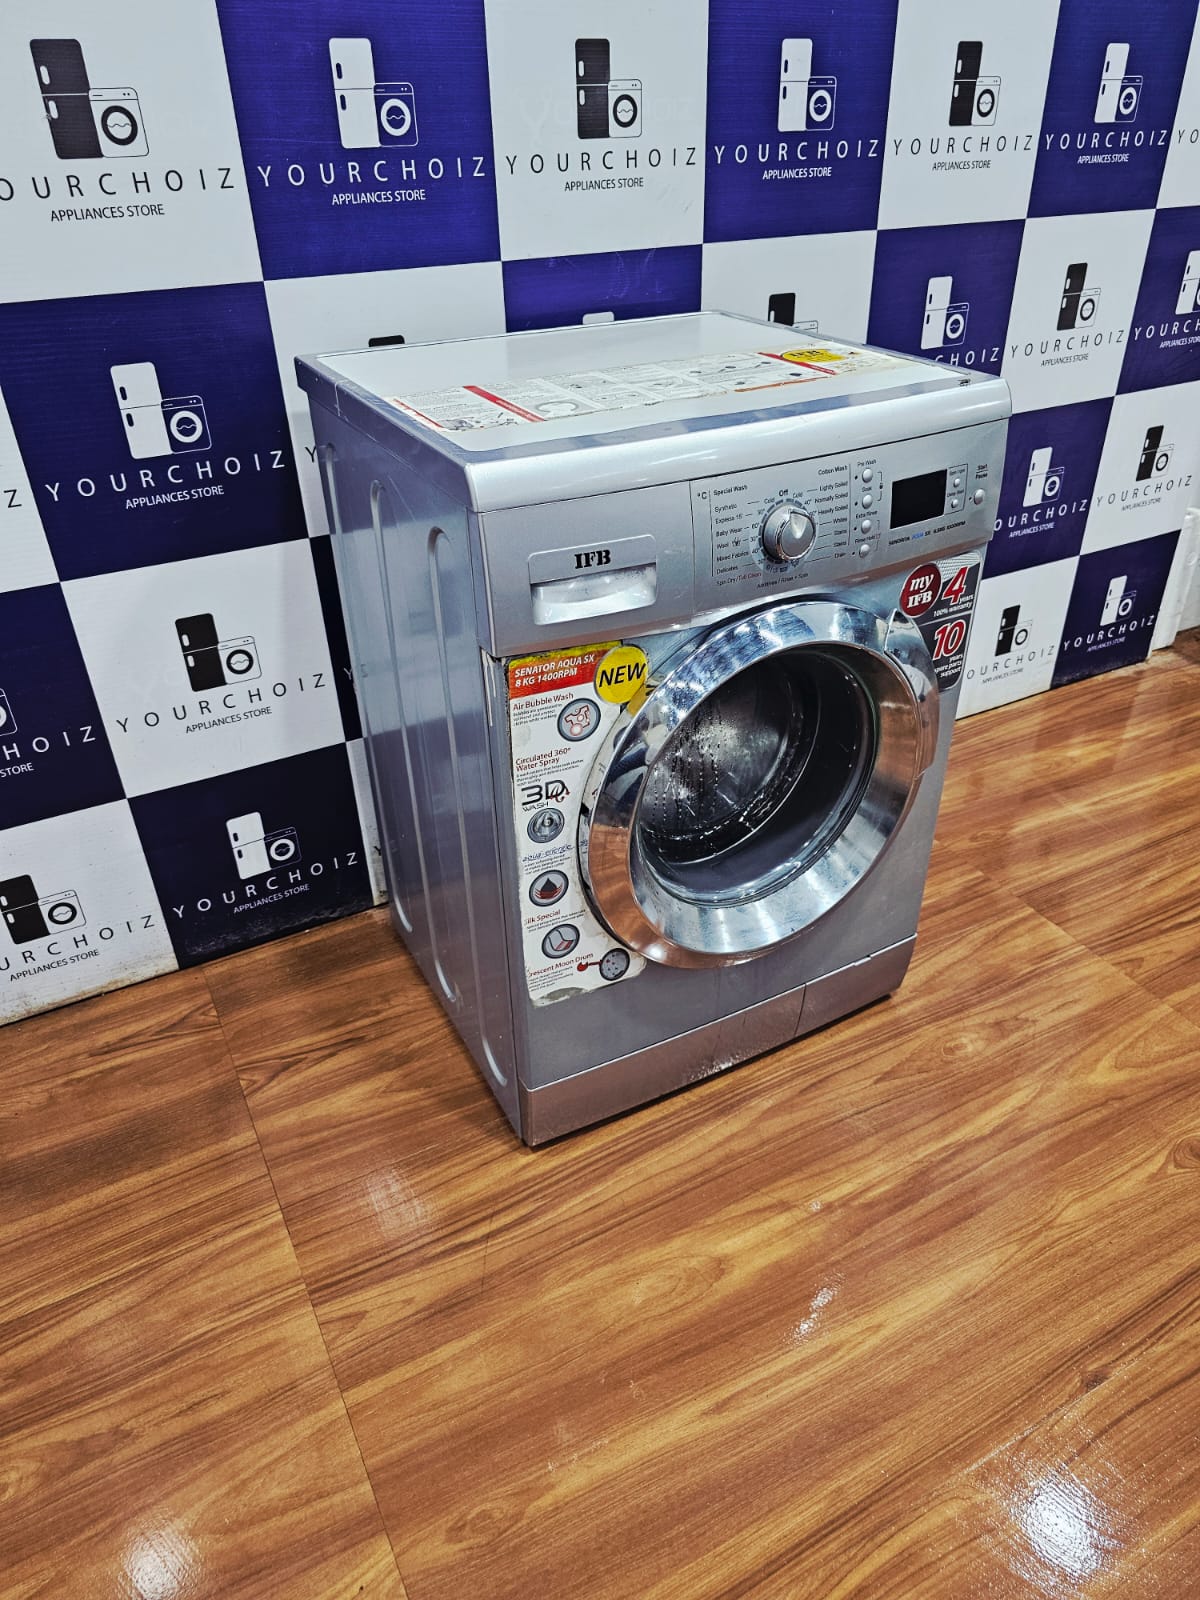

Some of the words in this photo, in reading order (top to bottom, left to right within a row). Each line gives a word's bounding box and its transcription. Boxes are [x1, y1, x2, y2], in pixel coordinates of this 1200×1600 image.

[893, 135, 1033, 156] YOURCHOIZ
[1044, 130, 1168, 151] YOURCHOIZ
[505, 147, 697, 175] YOURCHOIZ
[715, 139, 879, 165] YOURCHOIZ
[1078, 154, 1111, 164] APPLIANCES
[1111, 153, 1130, 163] STORE
[258, 157, 486, 187] YOURCHOIZ
[763, 168, 801, 180] APPLIANCES
[802, 167, 832, 178] STORE
[932, 161, 965, 171] APPLIANCES
[966, 160, 991, 169] STORE
[564, 181, 615, 193] APPLIANCES
[617, 177, 643, 189] STORE
[332, 192, 394, 206] APPLIANCES
[396, 189, 426, 202] STORE
[50, 206, 125, 222] APPLIANCES
[127, 204, 165, 218] STORE
[1011, 329, 1125, 359] YOURCHOIZ
[1040, 355, 1072, 367] APPLIANCES
[1072, 353, 1089, 363] STORE
[46, 450, 285, 502] YOURCHOIZ
[3, 489, 22, 508] Z
[125, 489, 190, 510] APPLIANCES
[191, 485, 224, 500] STORE
[778, 489, 789, 497] Off
[1096, 475, 1193, 507] YOURCHOIZ
[1008, 526, 1038, 538] APPLIANCES
[1038, 522, 1055, 533] STORE
[574, 549, 611, 569] IFB
[910, 574, 934, 593] my
[941, 566, 969, 606] 4
[907, 590, 933, 609] IFB
[932, 619, 966, 660] 10
[1063, 615, 1155, 652] YOURCHOIZ
[514, 662, 555, 678] SENATOR
[555, 657, 582, 670] AQUA
[583, 653, 595, 665] SX
[598, 662, 647, 688] NEW
[515, 680, 521, 688] 8
[522, 676, 535, 687] KG
[537, 667, 578, 683] 1400RPM
[116, 673, 326, 733] YOURCHOIZ
[513, 703, 524, 711] Air
[525, 696, 553, 709] Bubble
[553, 692, 574, 703] Wash
[185, 714, 242, 734] APPLIANCES
[243, 706, 272, 721] STORE
[515, 750, 553, 766] Circulated
[516, 761, 538, 772] Water
[539, 757, 560, 767] Spray
[173, 852, 358, 919] YOURCHOIZ
[233, 890, 278, 914] APPLIANCES
[279, 883, 310, 898] STORE
[536, 909, 561, 922] Special
[10, 959, 69, 981] APPLIANCES
[69, 949, 100, 963] STORE
[555, 959, 574, 969] Moon
[575, 953, 594, 963] Drum
